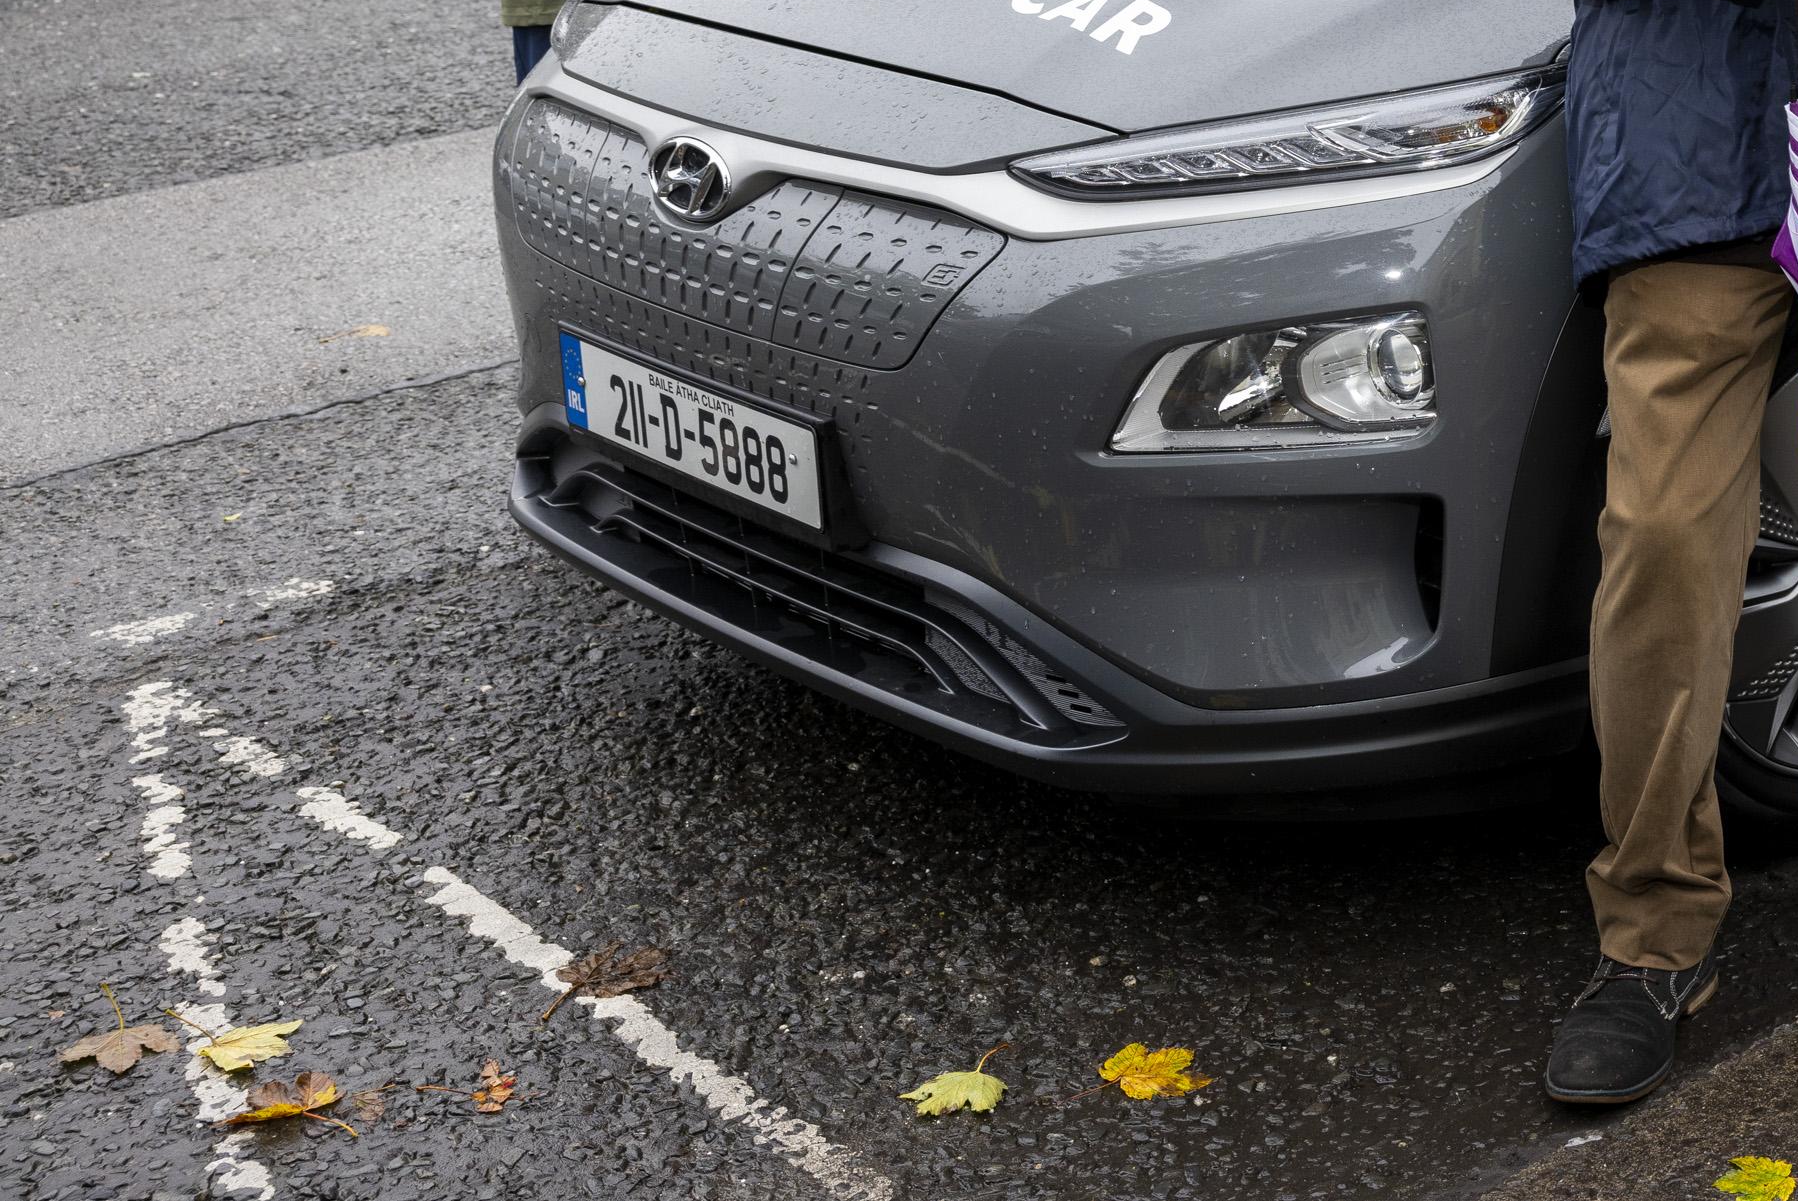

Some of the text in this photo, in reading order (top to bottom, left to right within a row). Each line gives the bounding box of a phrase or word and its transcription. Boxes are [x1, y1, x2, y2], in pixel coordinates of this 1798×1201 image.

[567, 389, 585, 414] IRL
[649, 374, 734, 417] BAILE ÁTHA CLIATH
[610, 374, 788, 504] 211-D-5888
